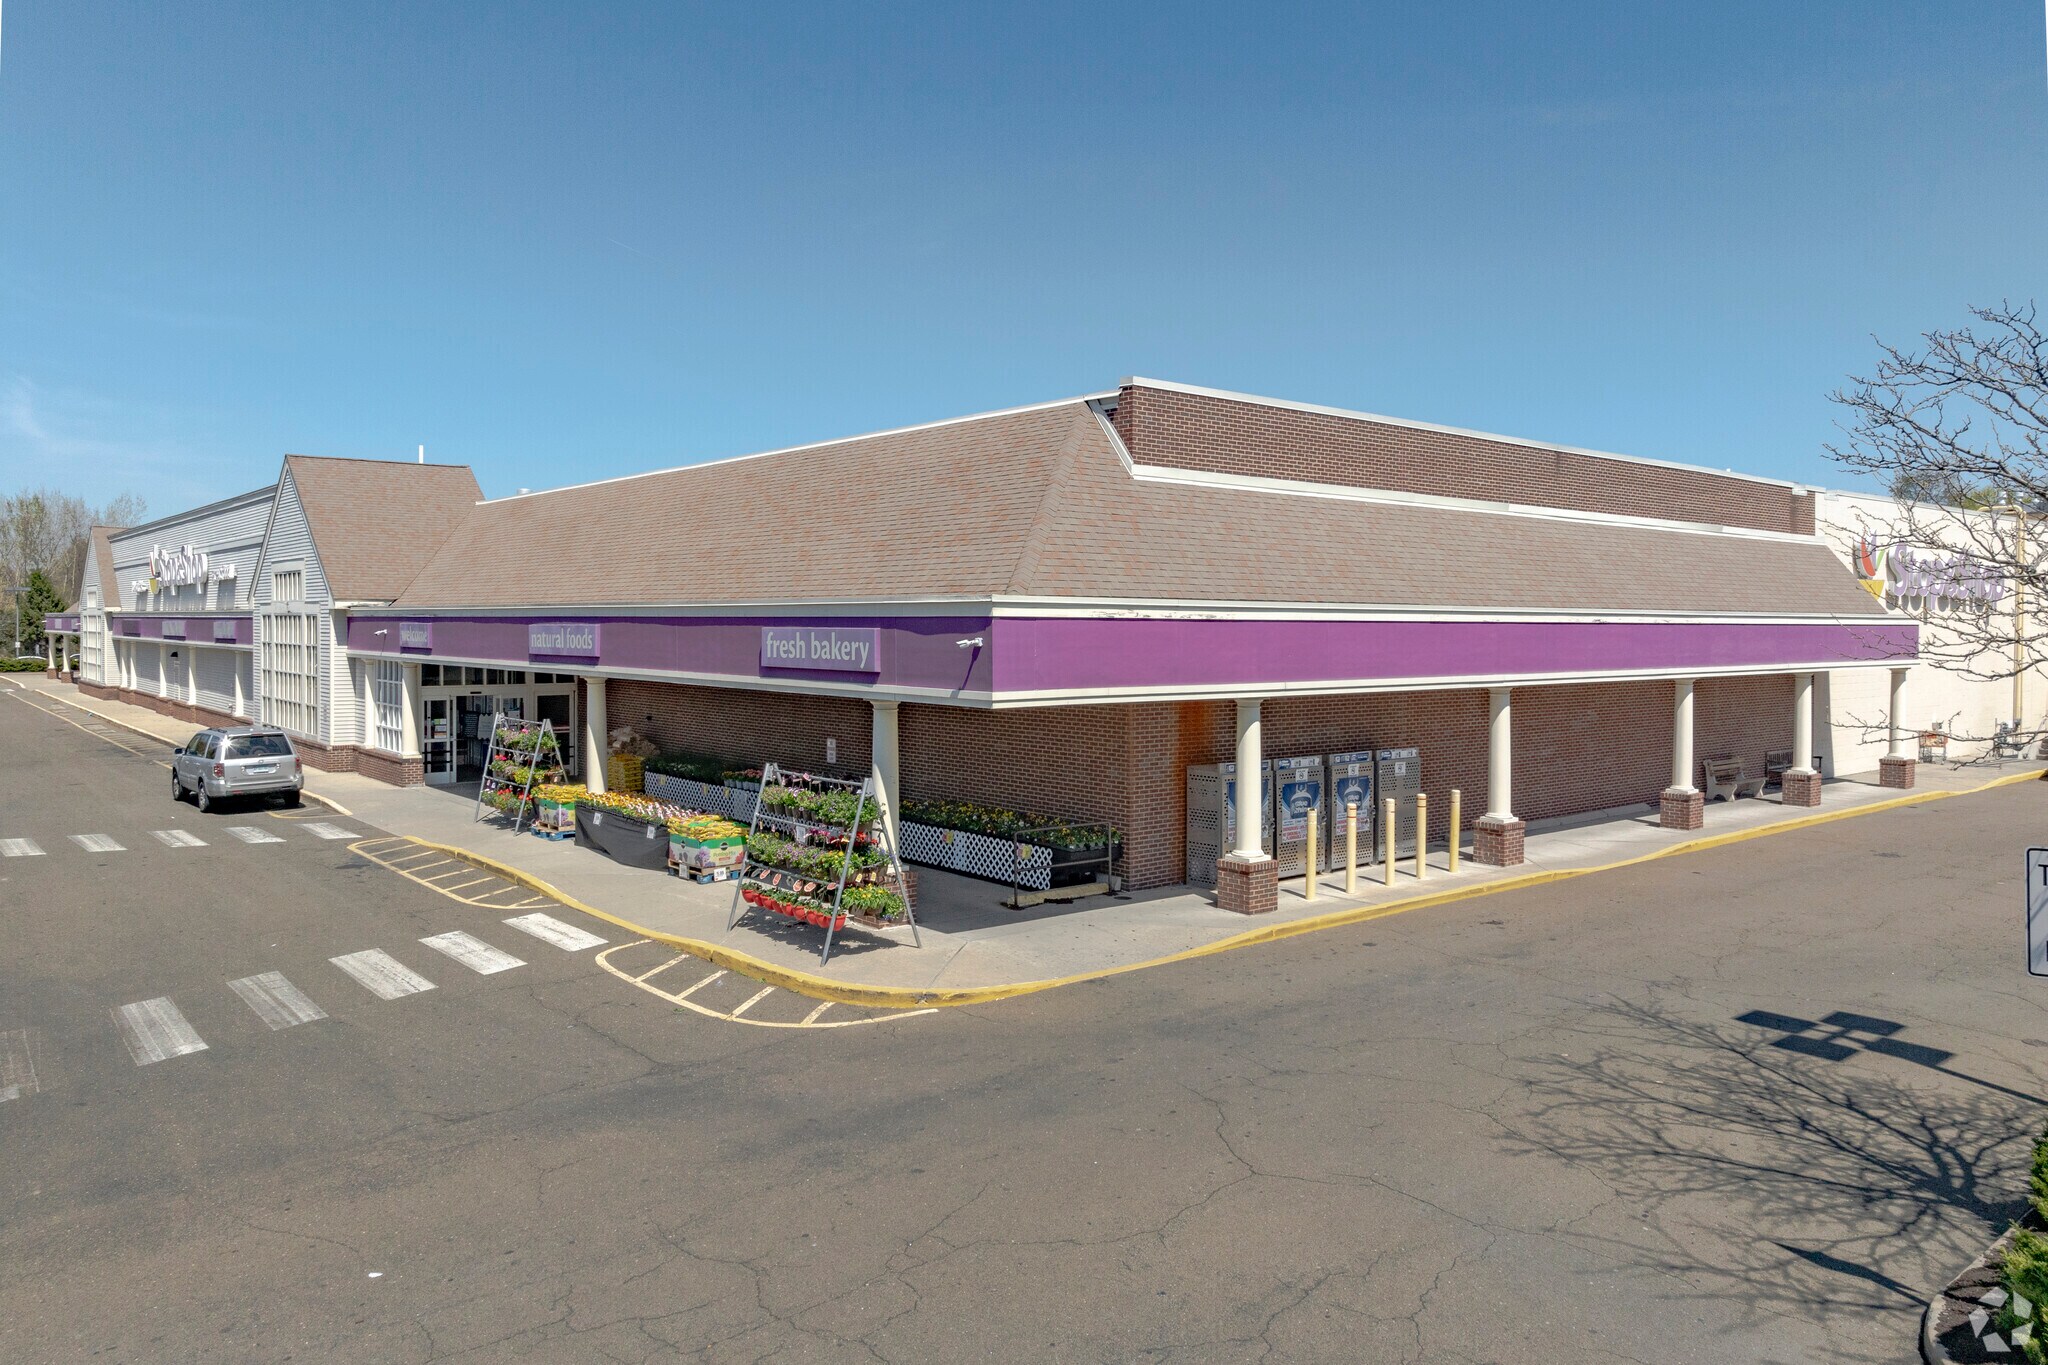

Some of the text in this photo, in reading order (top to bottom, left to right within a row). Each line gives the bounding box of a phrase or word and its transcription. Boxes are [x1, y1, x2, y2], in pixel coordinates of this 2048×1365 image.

[531, 627, 593, 650] natural foods
[766, 631, 870, 669] fresh bakery
